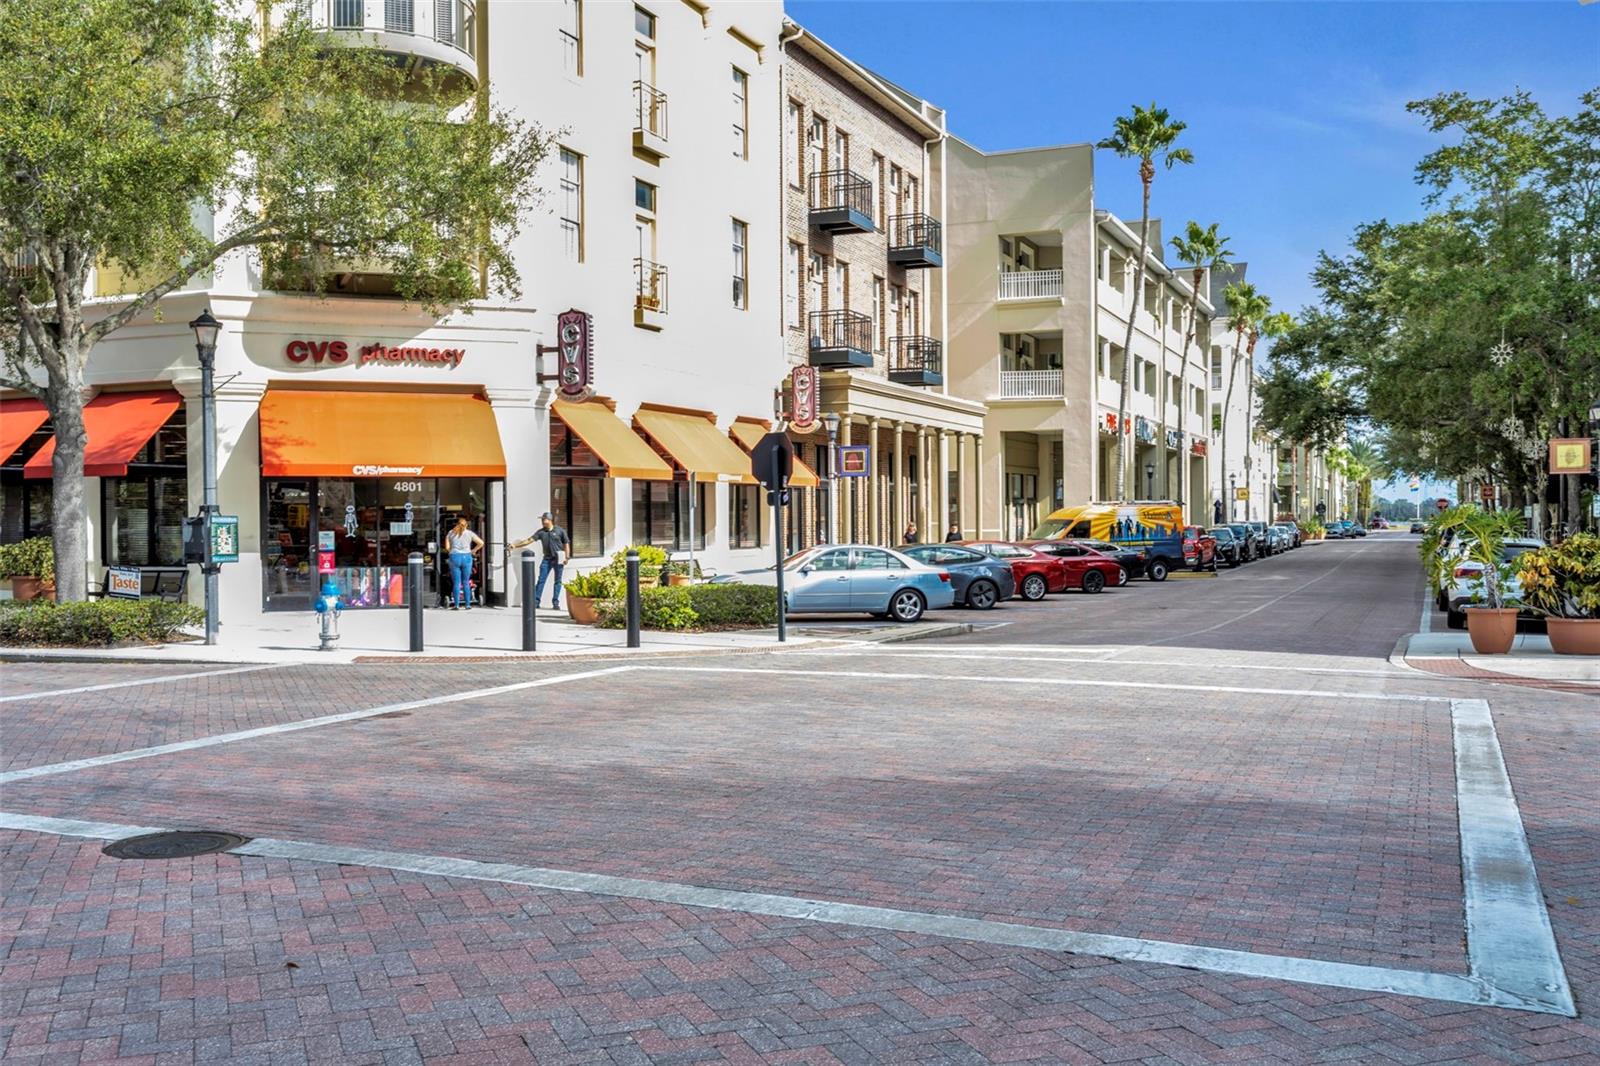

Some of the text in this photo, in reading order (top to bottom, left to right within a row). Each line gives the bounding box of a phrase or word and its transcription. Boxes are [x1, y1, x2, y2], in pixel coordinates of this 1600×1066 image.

[286, 340, 465, 370] CVS pharmacy
[562, 323, 580, 385] CVS
[795, 375, 811, 420] CVS
[394, 481, 422, 492] 4801
[111, 573, 139, 590] Taste
